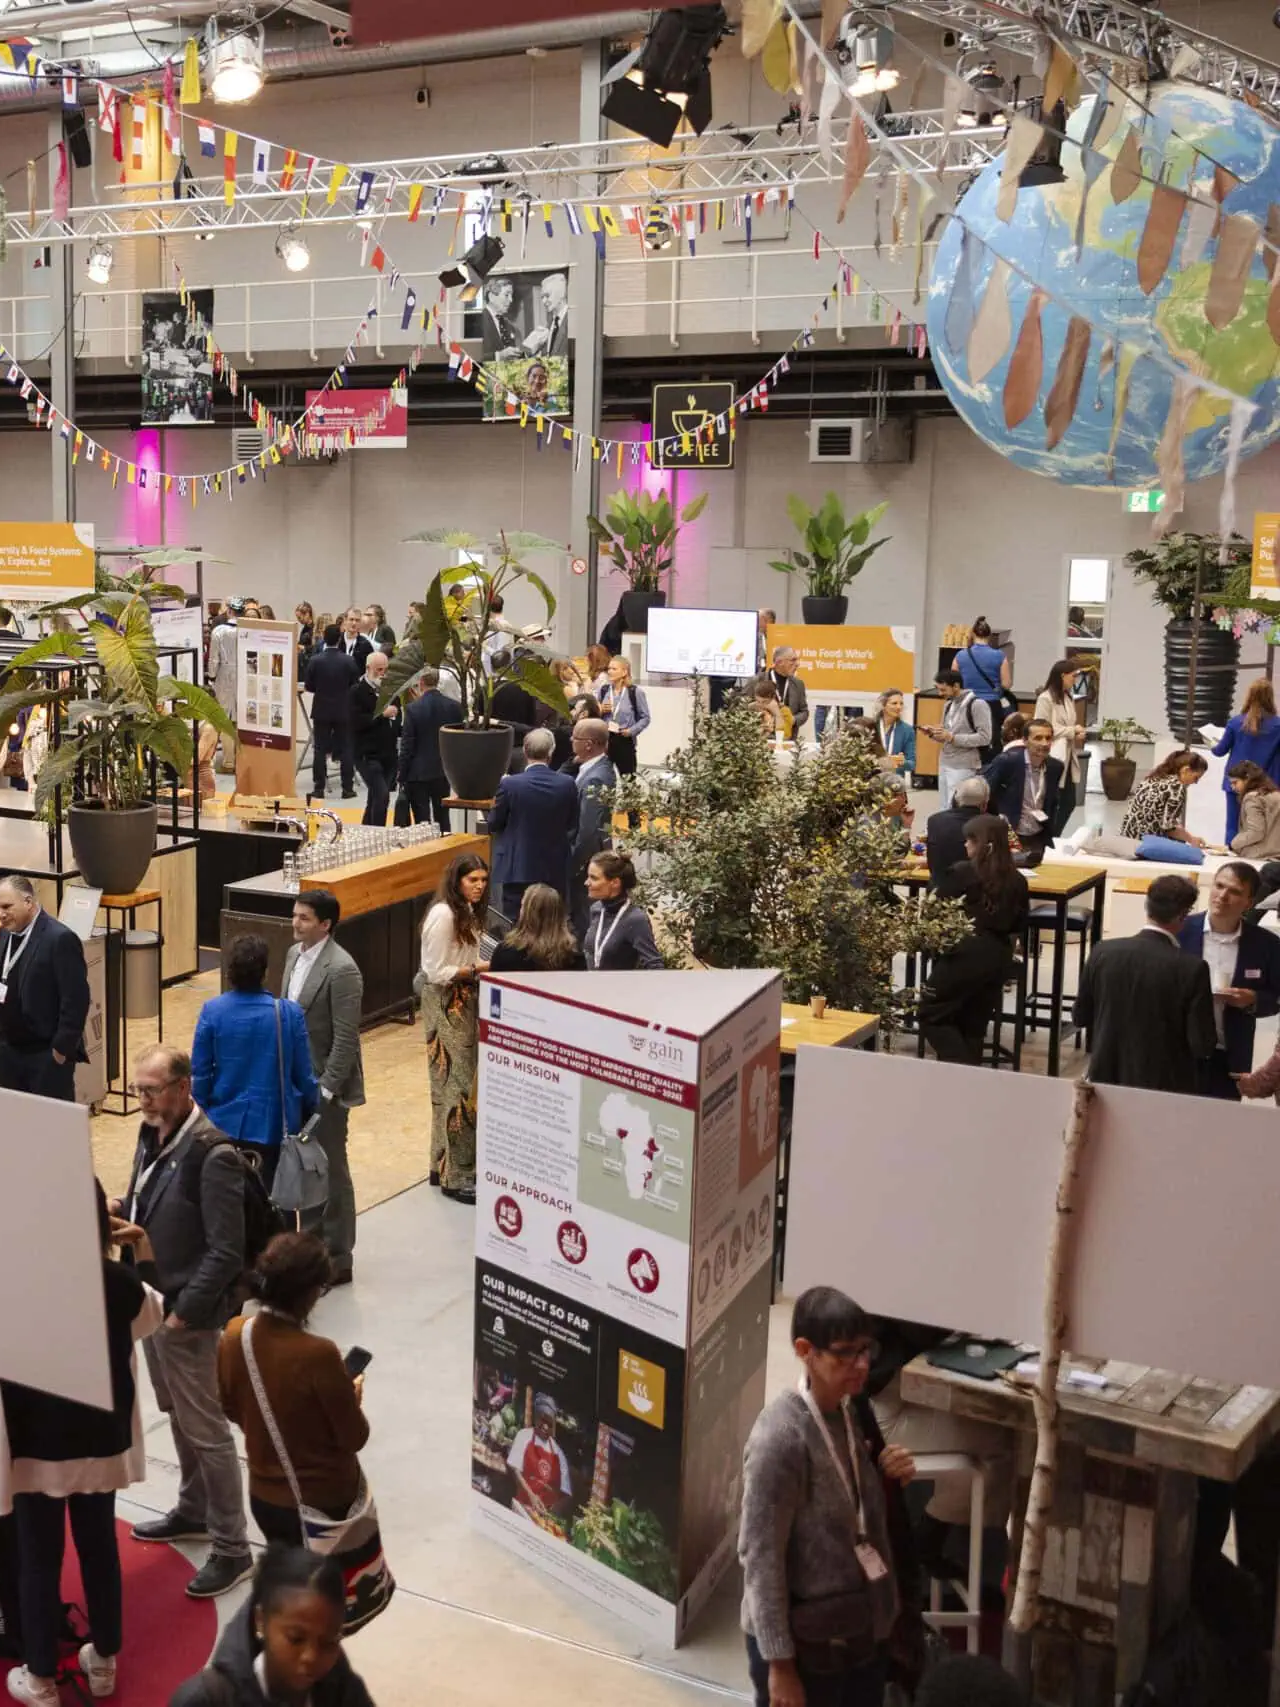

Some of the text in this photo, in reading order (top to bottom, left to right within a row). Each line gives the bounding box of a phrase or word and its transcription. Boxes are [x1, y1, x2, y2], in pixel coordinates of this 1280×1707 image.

[21, 546, 28, 554] &
[30, 546, 48, 555] Food
[38, 558, 51, 566] Act
[802, 648, 817, 657] the
[815, 660, 834, 669] Your
[486, 1049, 560, 1085] OUR MISSION
[537, 1039, 558, 1053] FOOD
[558, 1046, 589, 1062] SYSTEMS
[589, 1055, 599, 1066] TO
[600, 1059, 633, 1076] IMPROVE
[633, 1069, 650, 1082] DIET
[651, 1074, 683, 1093] QUALITY
[538, 1048, 553, 1060] FOR
[554, 1053, 568, 1065] THE
[569, 1058, 589, 1071] MOST
[589, 1064, 635, 1086] VULNERABLE
[647, 1033, 684, 1070] gain
[484, 1169, 572, 1215] OUR APPROACH
[482, 1272, 589, 1332] OUR IMPACT SO FAR
